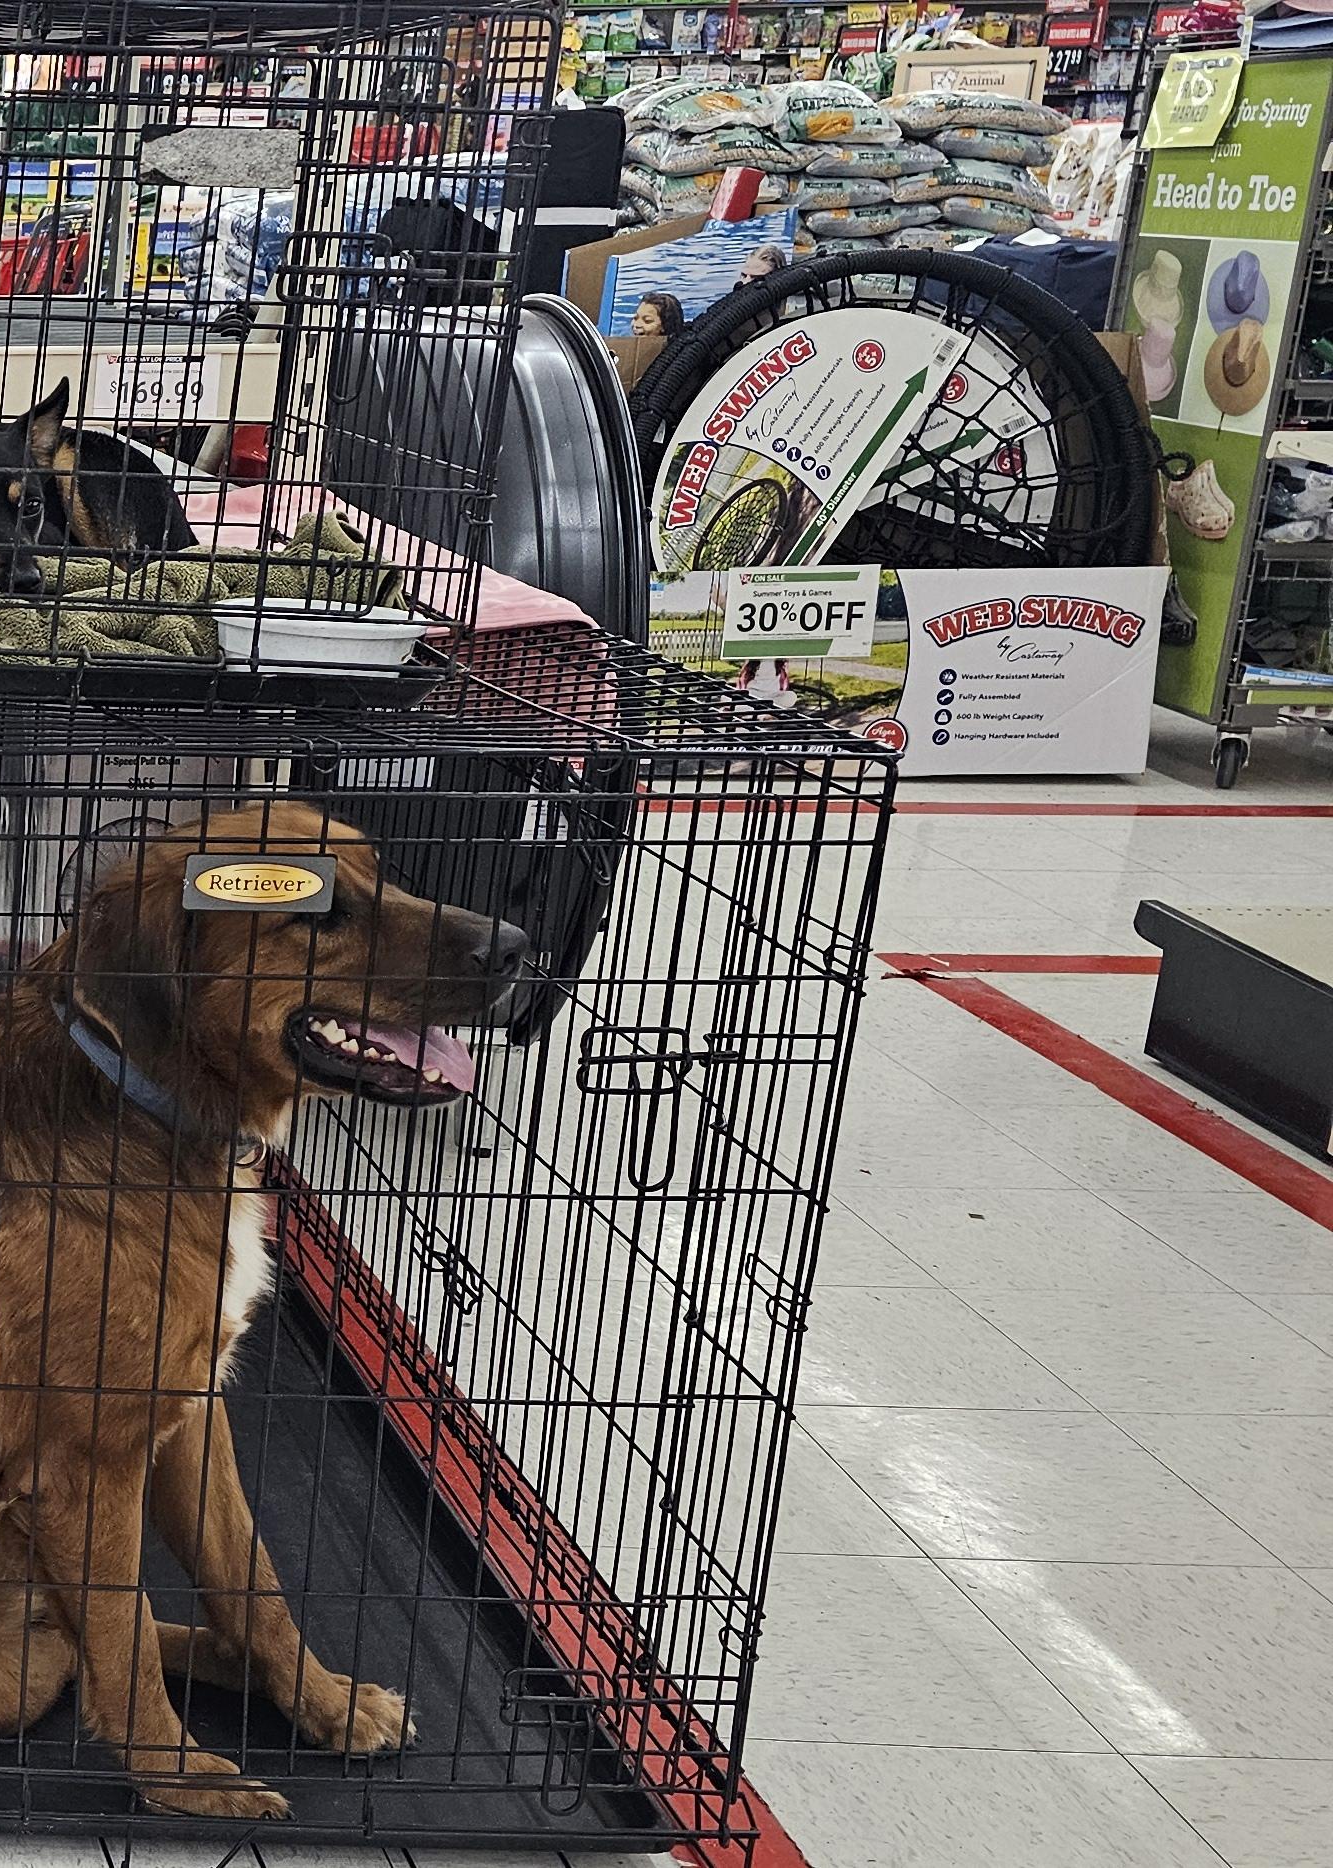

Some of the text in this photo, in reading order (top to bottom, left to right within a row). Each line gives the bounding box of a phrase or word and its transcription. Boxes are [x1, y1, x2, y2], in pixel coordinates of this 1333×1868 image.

[959, 75, 1005, 86] Animal
[1235, 97, 1312, 128] for Spring
[1211, 141, 1241, 163] from
[1153, 173, 1297, 212] Head to Toe
[785, 357, 843, 435] Weather Resistant Materials
[799, 398, 835, 446] Fully Assembled
[828, 414, 845, 437] Weight
[843, 388, 864, 414] Capacity
[828, 384, 886, 464] Hanging Hardware Included
[665, 330, 816, 530] WEB SWING
[746, 426, 760, 442] by
[827, 471, 858, 511] Diameter
[767, 574, 785, 582] SALE
[753, 590, 781, 598] Summer
[783, 590, 800, 599] Toys
[809, 589, 832, 597] Games
[923, 595, 1145, 648] WEB SWING
[997, 636, 1074, 666] by Castaway
[1013, 713, 1044, 721] Capacity
[871, 727, 895, 738] Ages
[954, 733, 987, 741] Hanging
[209, 874, 305, 891] Retriever
